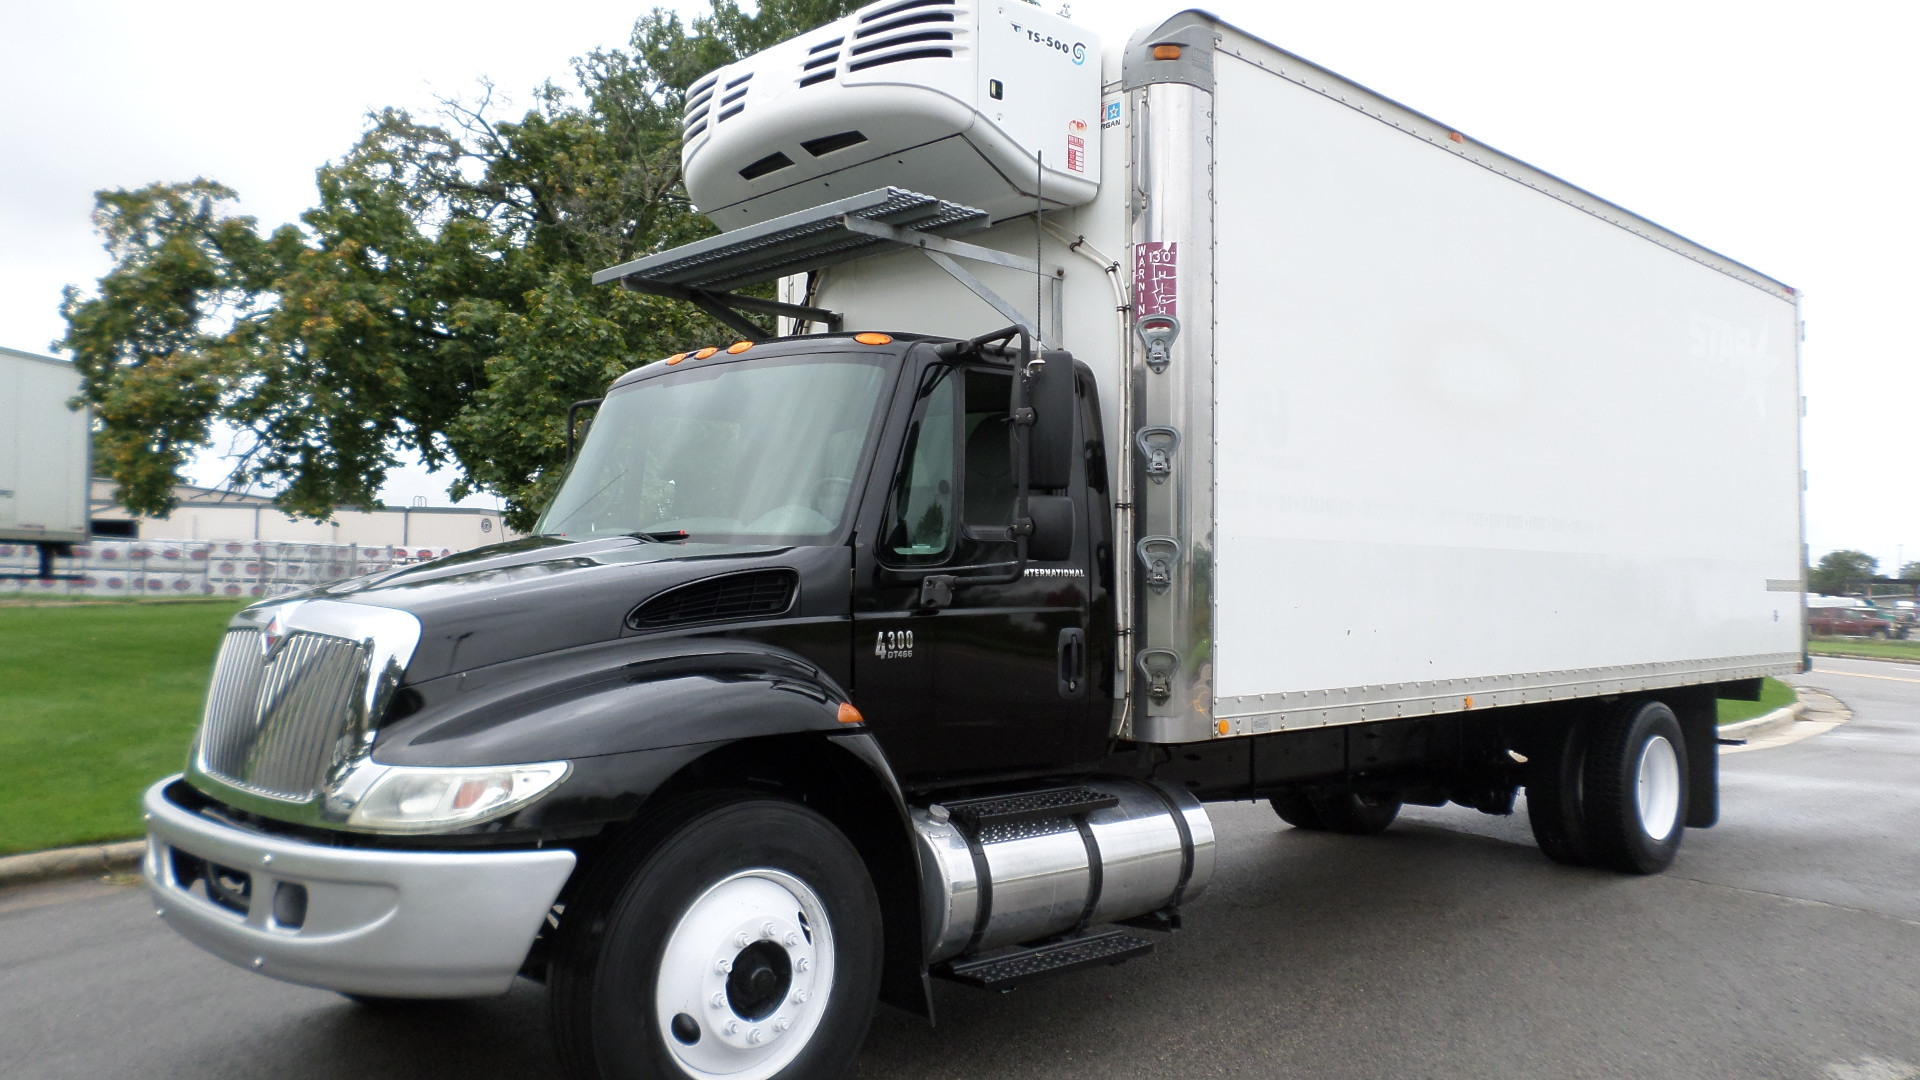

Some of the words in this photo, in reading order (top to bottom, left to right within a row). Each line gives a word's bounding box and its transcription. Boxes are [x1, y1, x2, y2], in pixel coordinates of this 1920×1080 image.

[1027, 29, 1069, 54] TS-500
[1101, 119, 1120, 130] RGAN
[1138, 245, 1147, 318] WARNIN
[1023, 568, 1085, 578] NTERNATIONAL
[875, 630, 914, 660] 4300
[887, 650, 913, 659] DT466
